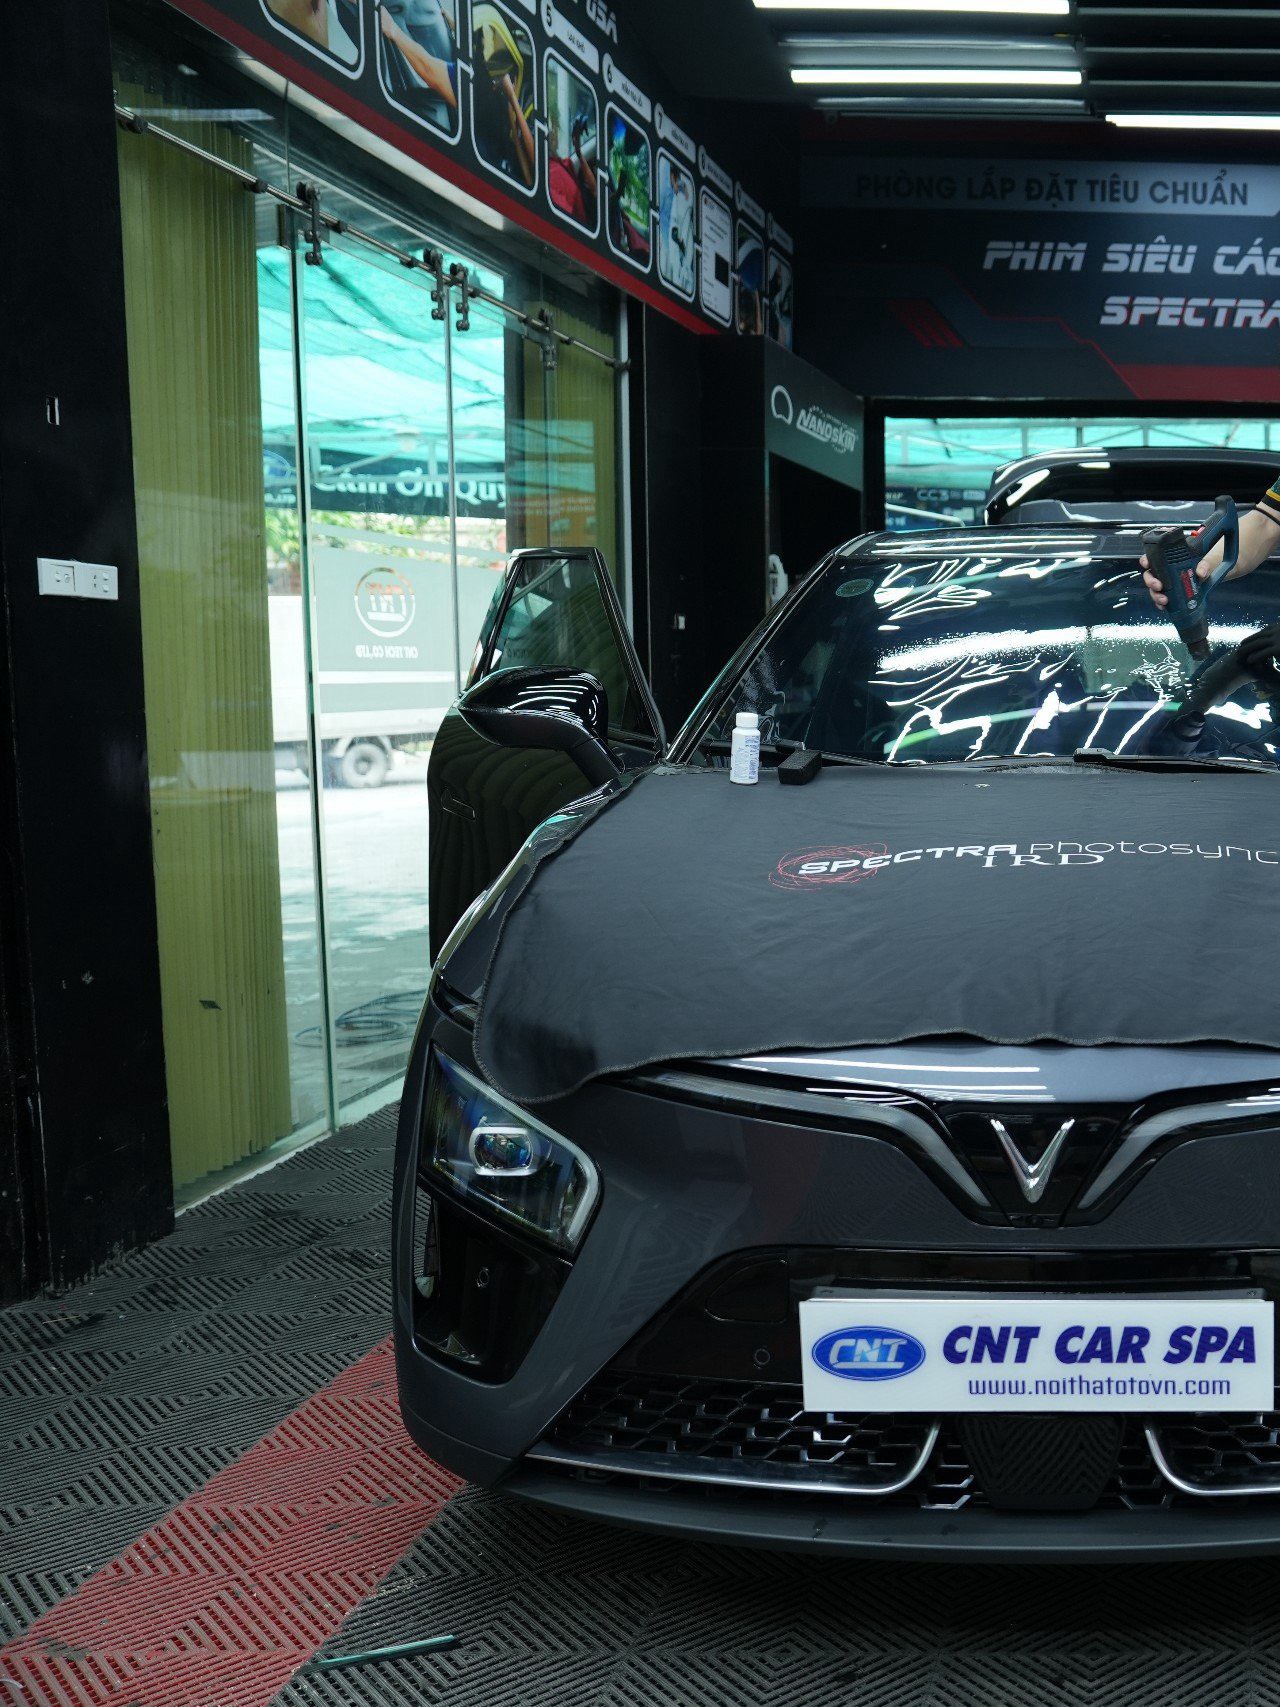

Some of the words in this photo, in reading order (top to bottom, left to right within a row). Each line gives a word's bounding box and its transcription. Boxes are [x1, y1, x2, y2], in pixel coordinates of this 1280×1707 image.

[857, 170, 957, 199] PHÒNG
[967, 168, 1015, 201] LẮP
[1024, 172, 1078, 208] ĐẶT
[1086, 173, 1139, 203] TIÊU
[1149, 168, 1248, 206] CHUẨN
[983, 241, 1087, 271] PHIM
[1102, 235, 1197, 275] SIÊU
[797, 408, 856, 452] NANOSKIN
[798, 844, 1018, 876] SPECTRA
[982, 853, 1105, 868] IRD
[829, 1338, 907, 1370] CNT
[942, 1325, 1041, 1364] CNT
[1054, 1325, 1151, 1365] CAR
[1163, 1325, 1257, 1365] SPA
[968, 1374, 1231, 1396] www.noithatotovn.com
